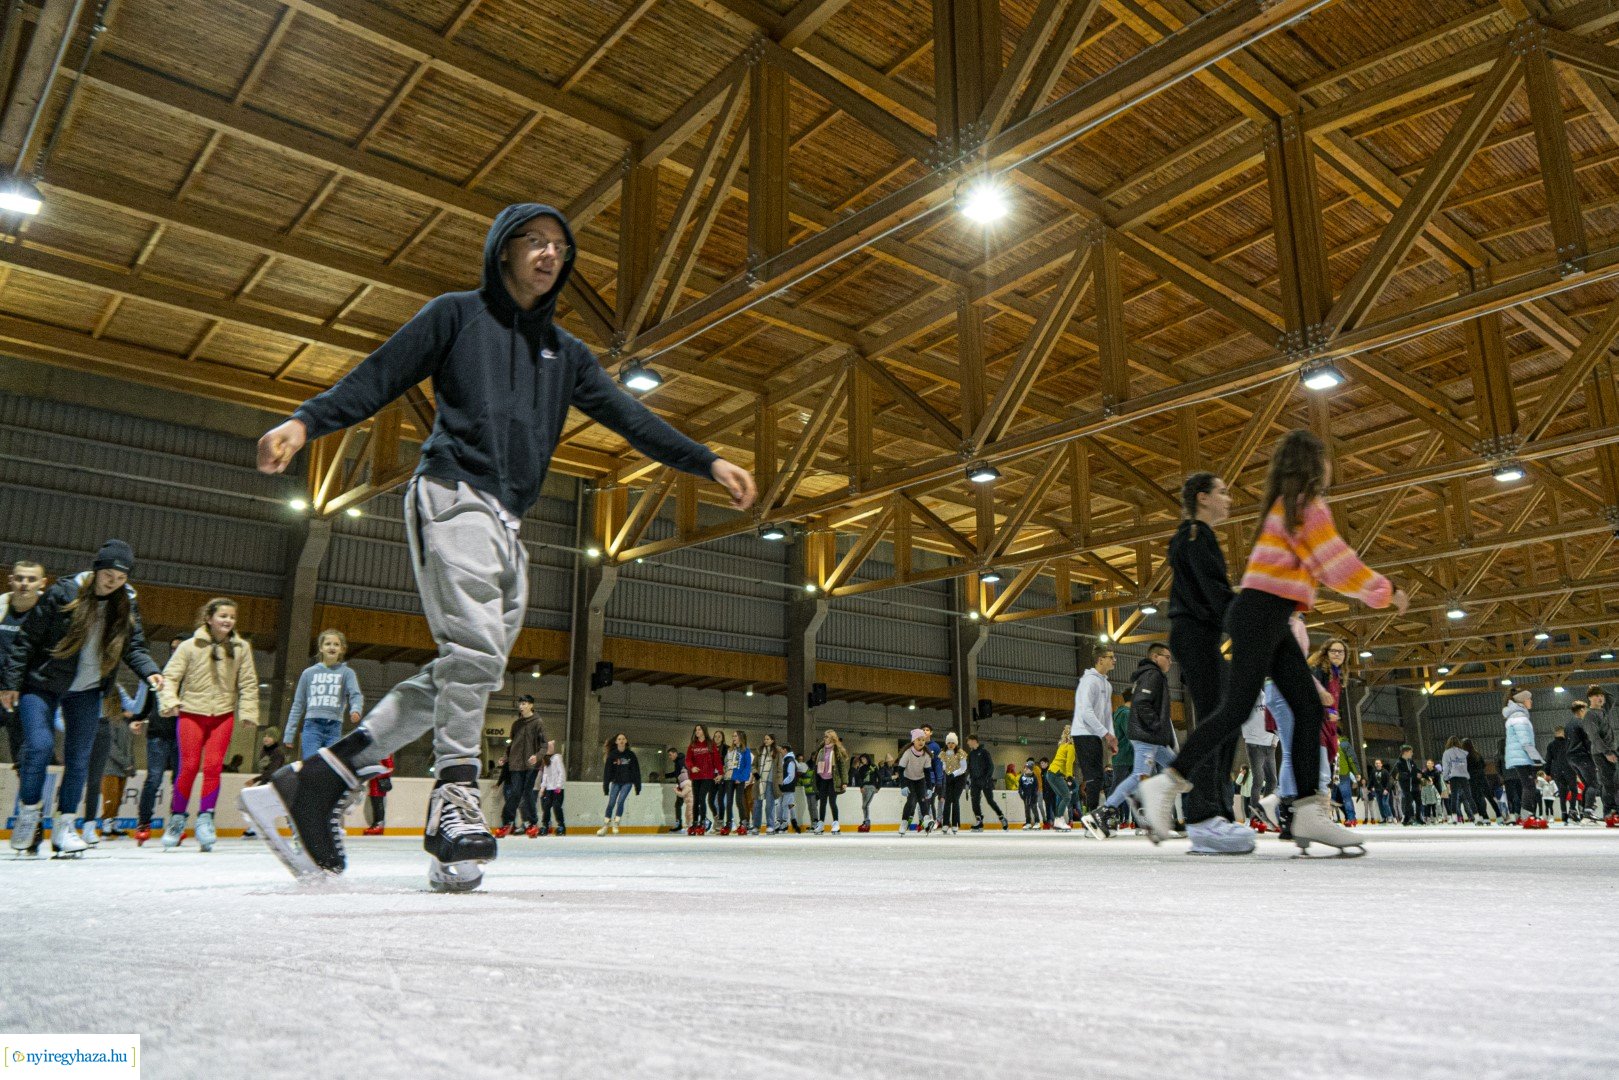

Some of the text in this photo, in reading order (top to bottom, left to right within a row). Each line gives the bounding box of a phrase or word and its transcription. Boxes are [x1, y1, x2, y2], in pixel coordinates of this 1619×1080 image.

[311, 673, 341, 684] JUST
[310, 684, 341, 695] DO IT
